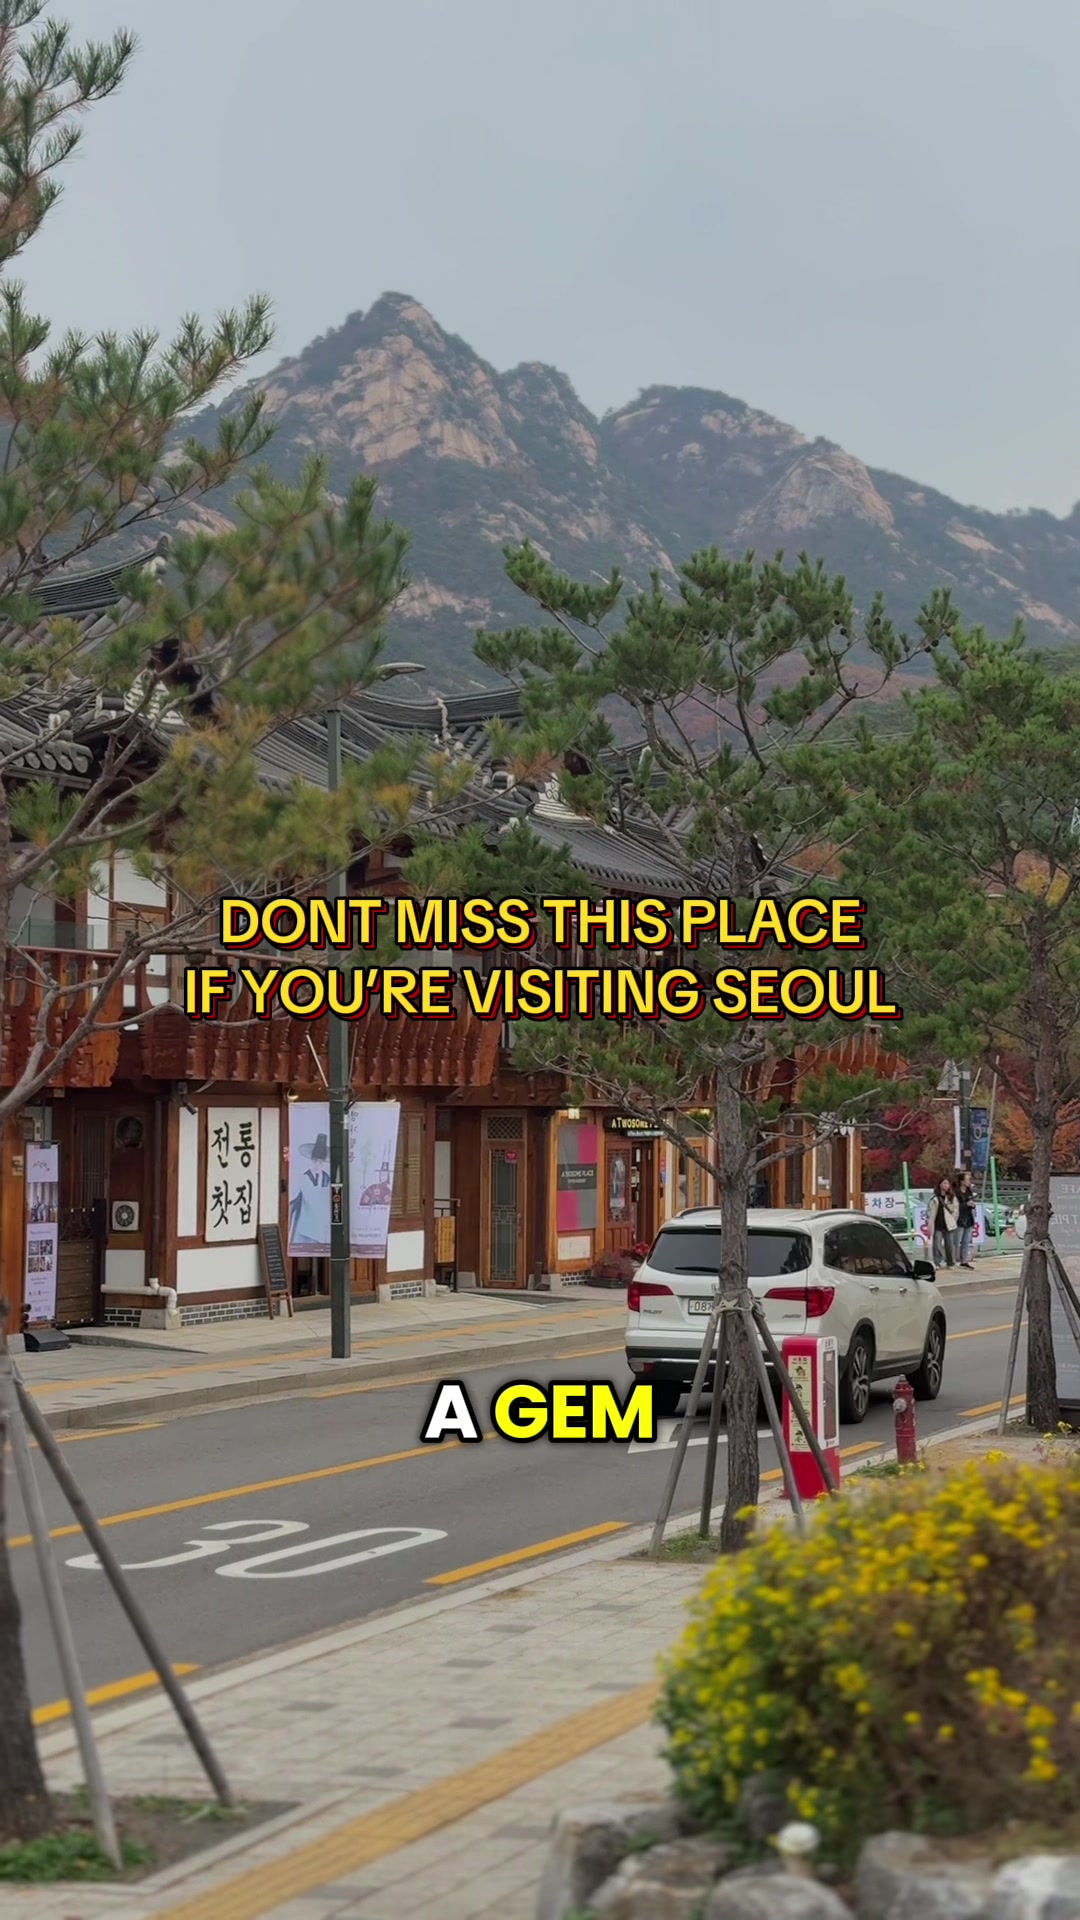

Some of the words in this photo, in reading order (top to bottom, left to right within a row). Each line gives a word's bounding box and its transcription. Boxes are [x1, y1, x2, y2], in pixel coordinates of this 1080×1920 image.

[211, 1121, 255, 1168] 전통
[211, 1179, 252, 1228] 찻집
[65, 1519, 448, 1579] 30
